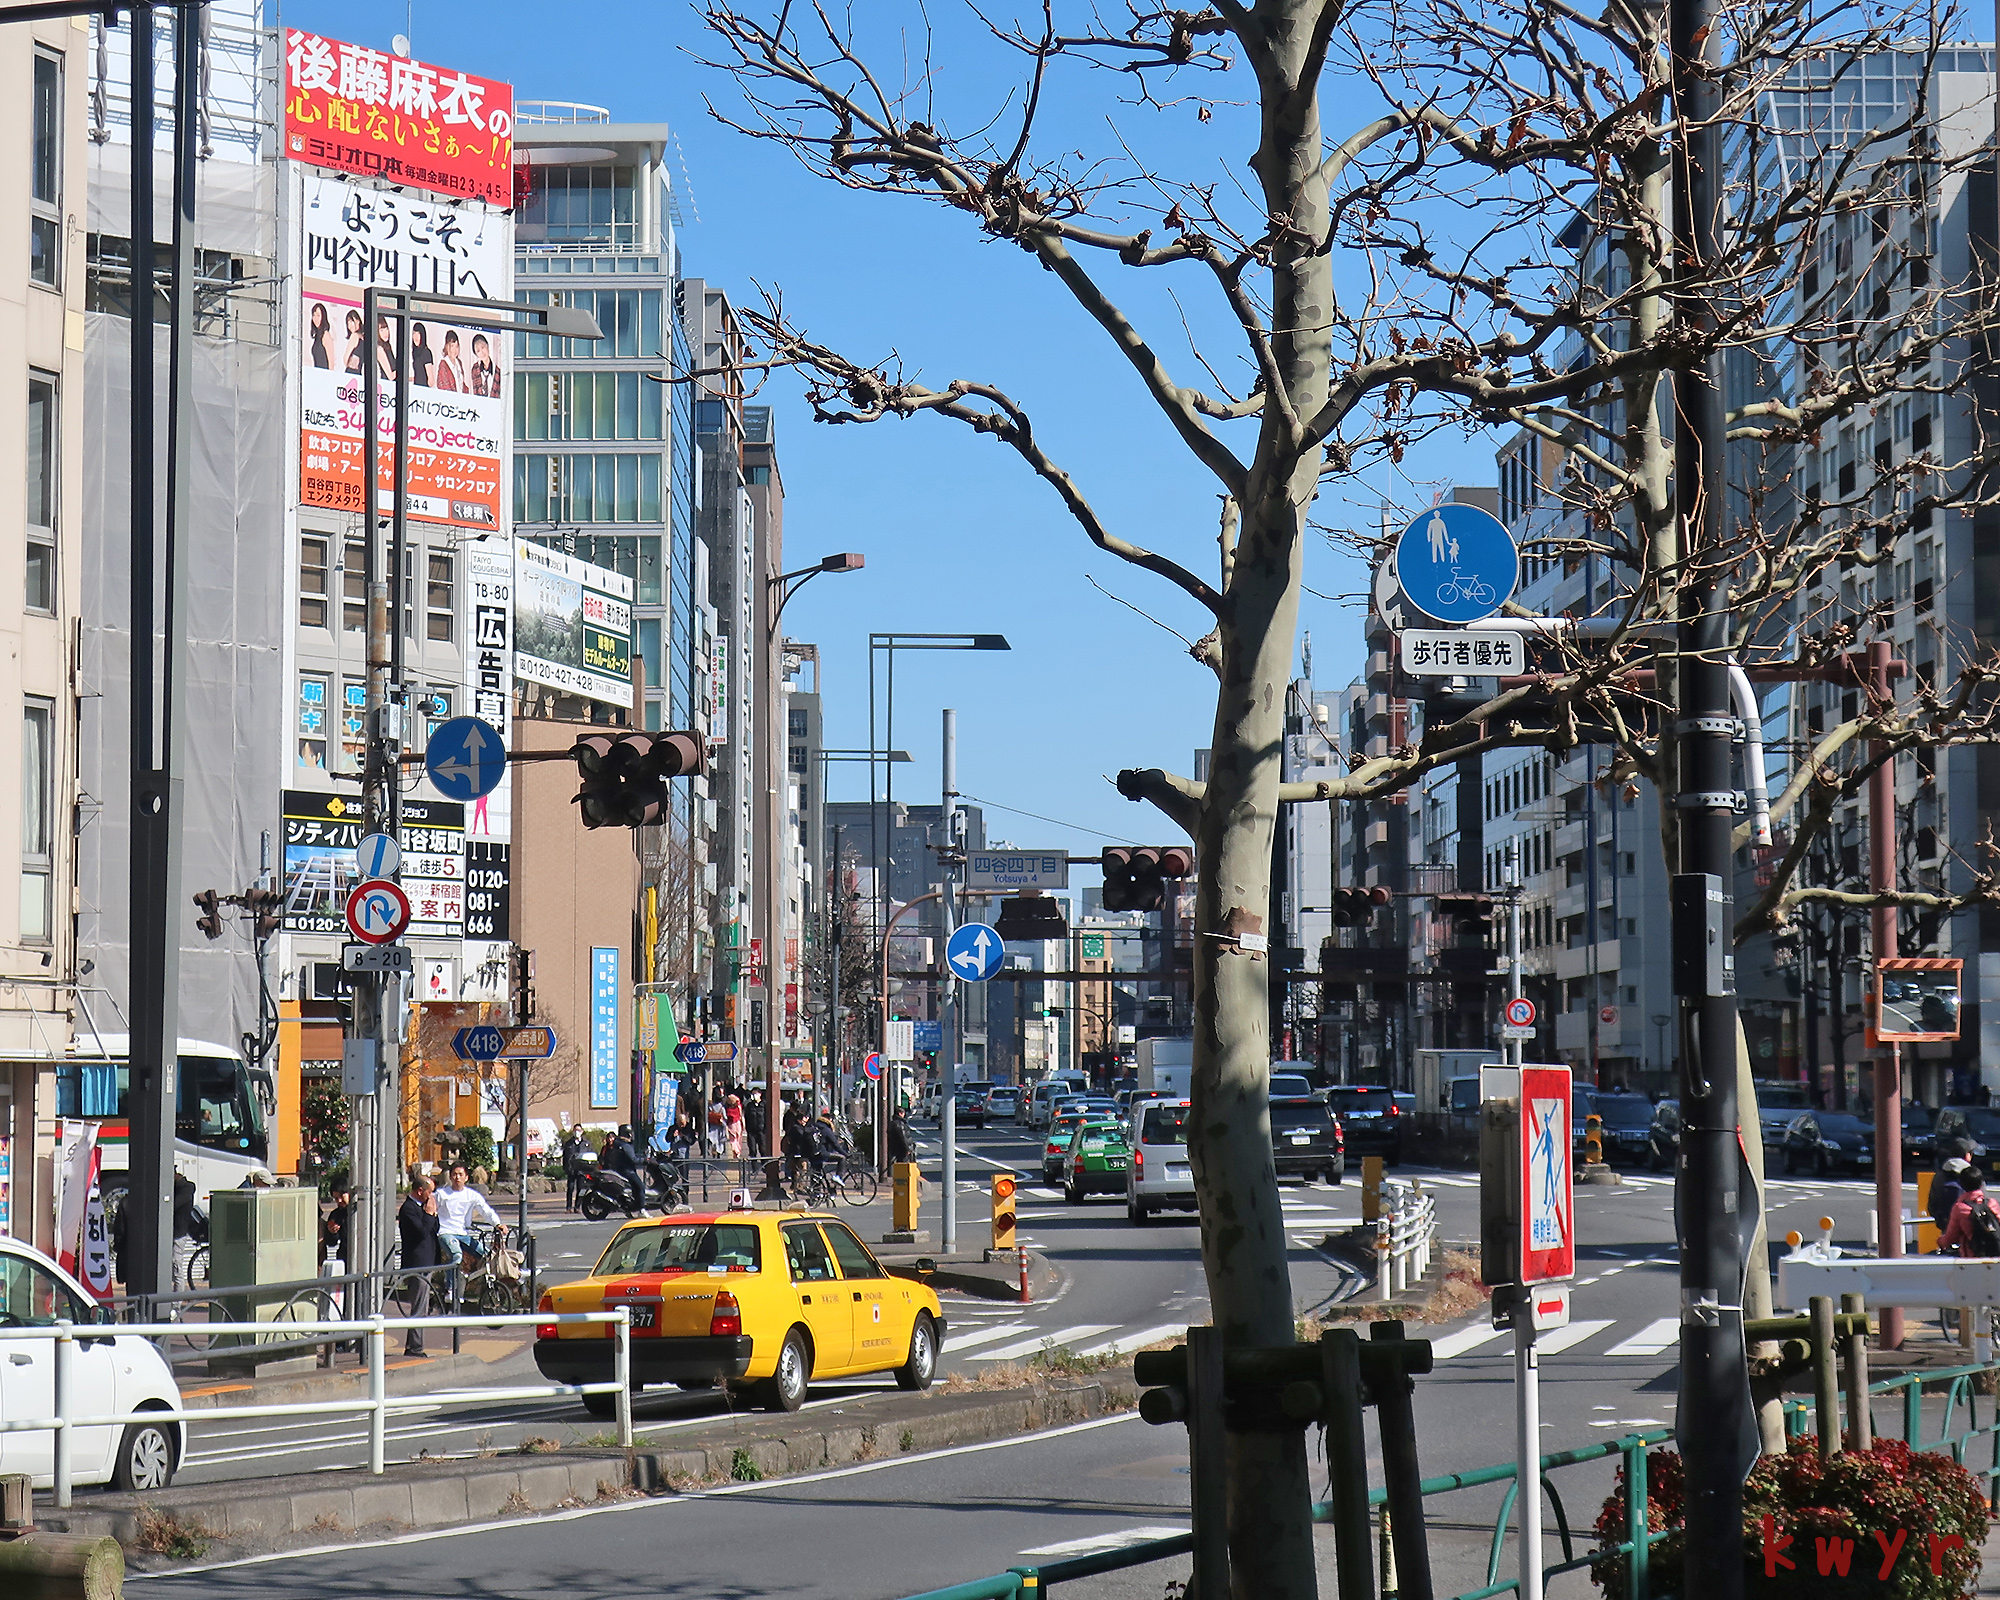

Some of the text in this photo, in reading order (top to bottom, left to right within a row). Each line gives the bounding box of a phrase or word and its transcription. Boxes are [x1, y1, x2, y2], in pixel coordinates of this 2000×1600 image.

[287, 31, 512, 138] 後藤麻衣の
[308, 232, 488, 300] 四谷四丁目へ
[307, 477, 361, 496] 四谷四丁目の
[462, 505, 484, 521] 検索
[472, 556, 492, 565] TAIYO
[472, 564, 509, 575] KOUGEISHA
[475, 583, 509, 600] TB-80
[1413, 640, 1512, 666] 歩行者優先
[527, 660, 593, 691] 0120-427-428
[974, 856, 1057, 874] 四谷四丁目
[467, 869, 509, 889] 0120-
[993, 873, 1038, 885] Yotsuya 4
[467, 892, 500, 912] 081-
[467, 916, 494, 935] 666
[470, 1033, 500, 1053] 418
[686, 1046, 704, 1059] 418
[669, 1228, 696, 1238] 2180
